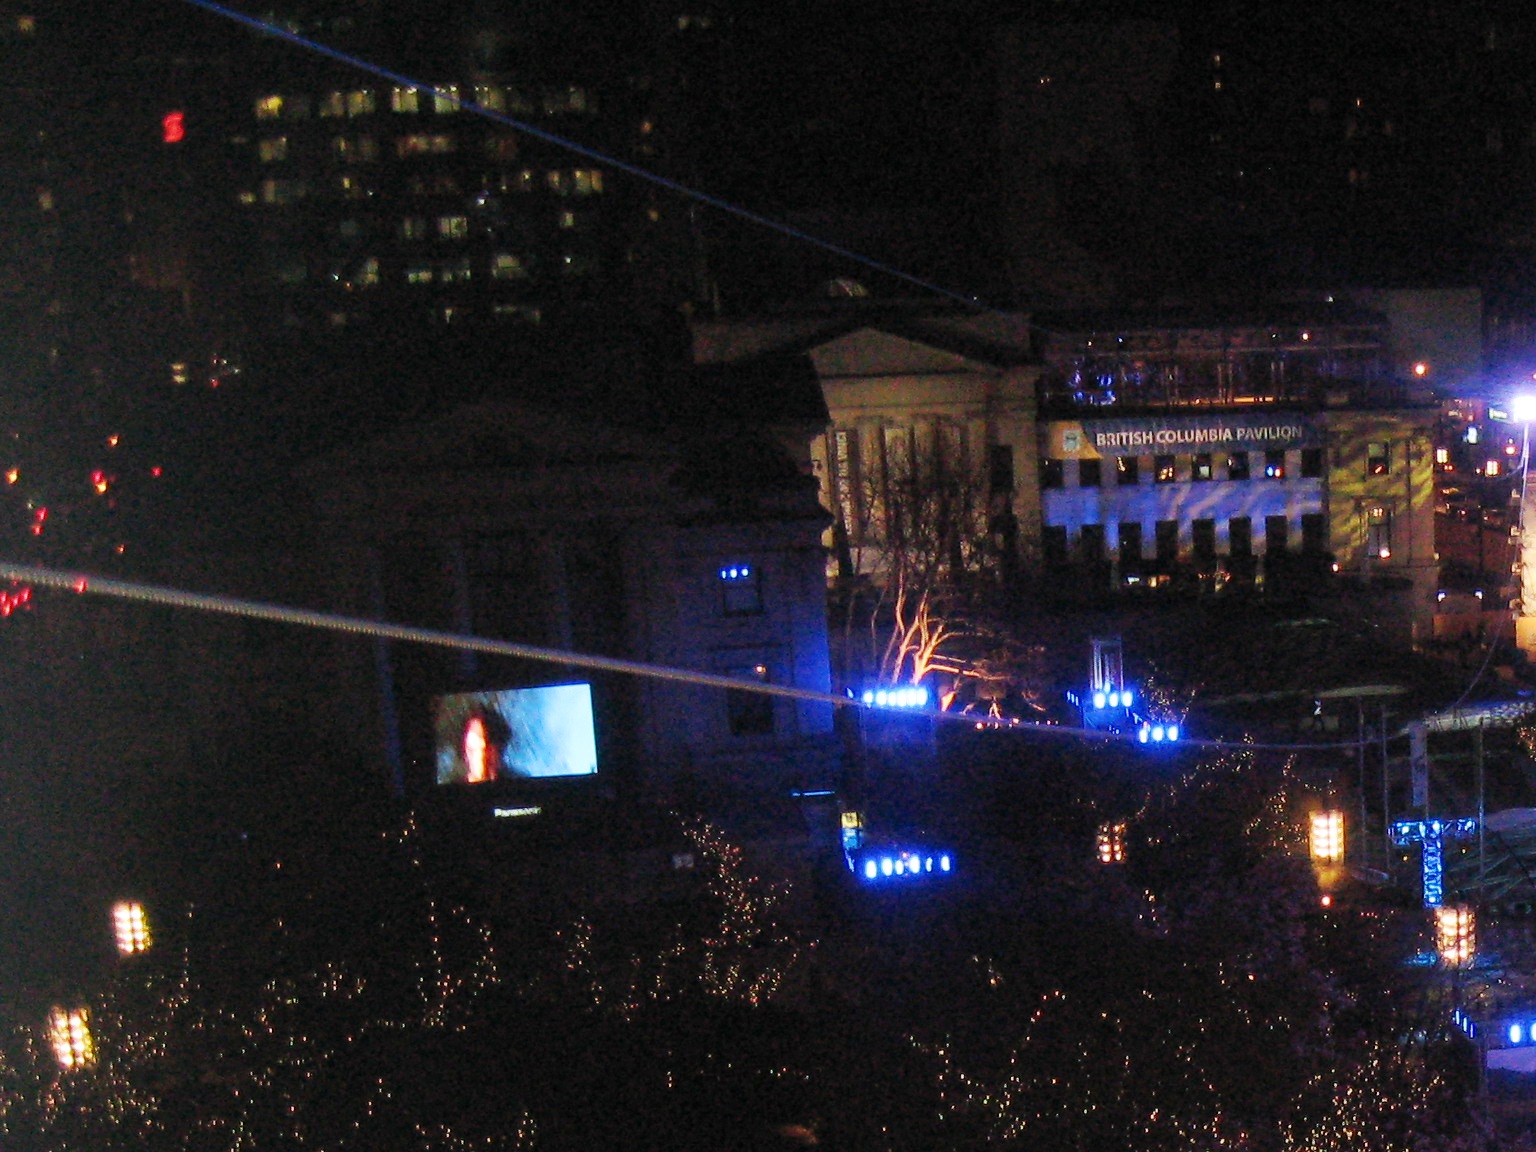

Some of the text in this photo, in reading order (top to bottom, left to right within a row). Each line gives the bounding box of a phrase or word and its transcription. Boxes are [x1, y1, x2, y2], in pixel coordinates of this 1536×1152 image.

[1096, 425, 1303, 447] BRITISH COLUMBIA PAVILION
